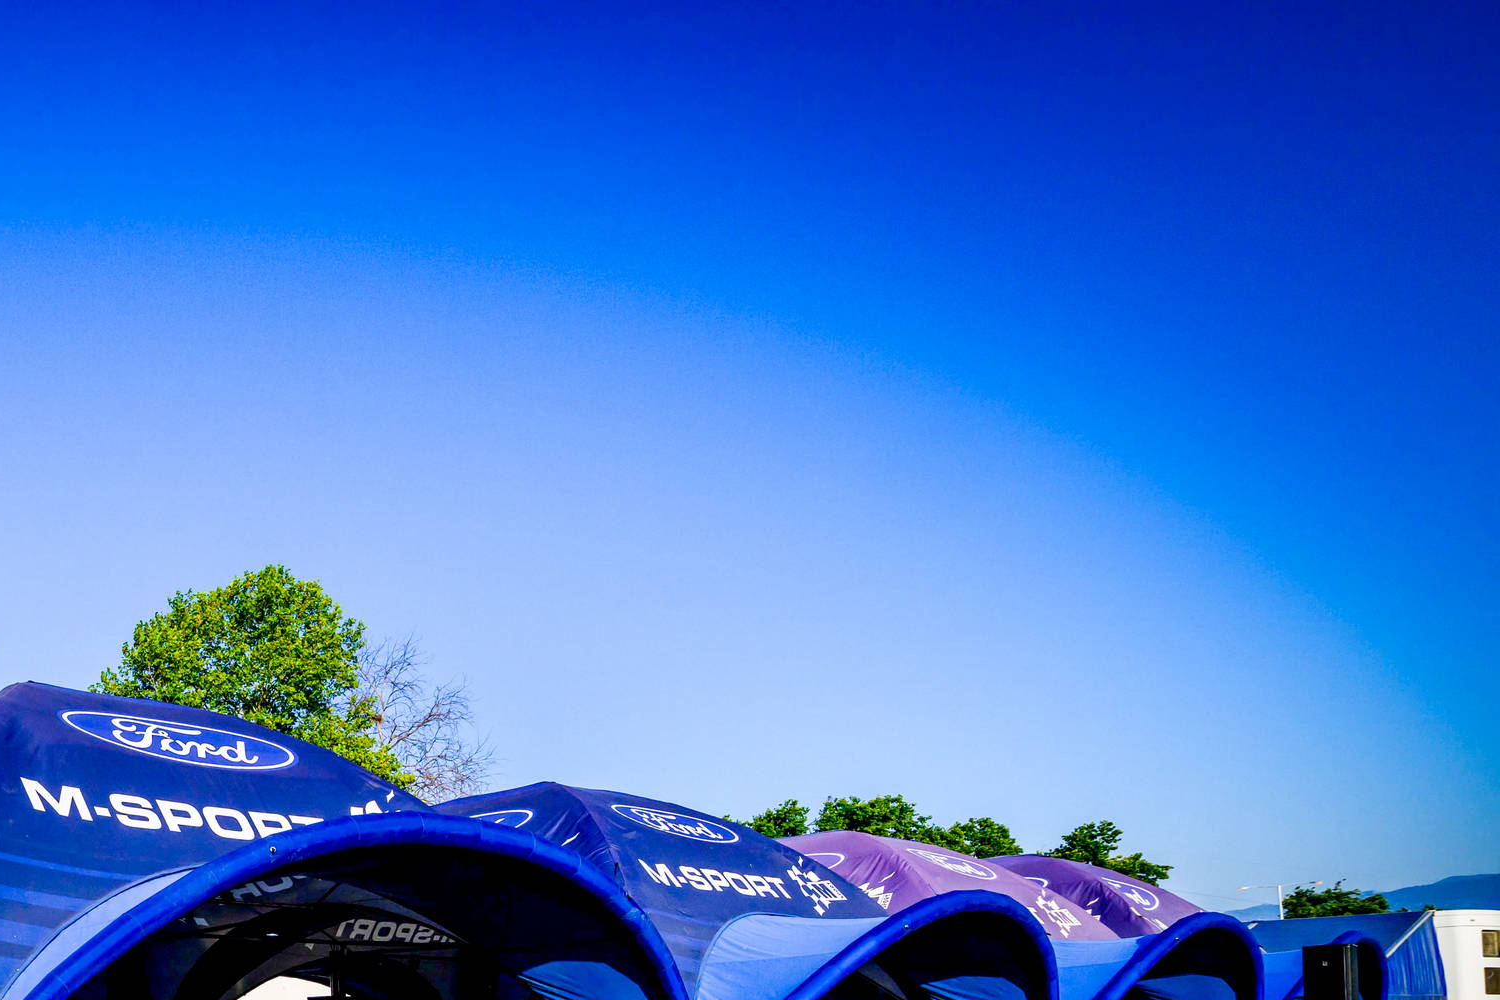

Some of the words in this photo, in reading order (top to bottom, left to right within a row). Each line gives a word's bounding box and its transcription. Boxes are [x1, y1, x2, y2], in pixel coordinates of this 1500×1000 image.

[112, 716, 260, 766] Ford
[630, 808, 723, 840] Ford
[638, 859, 792, 900] M-SPORT
